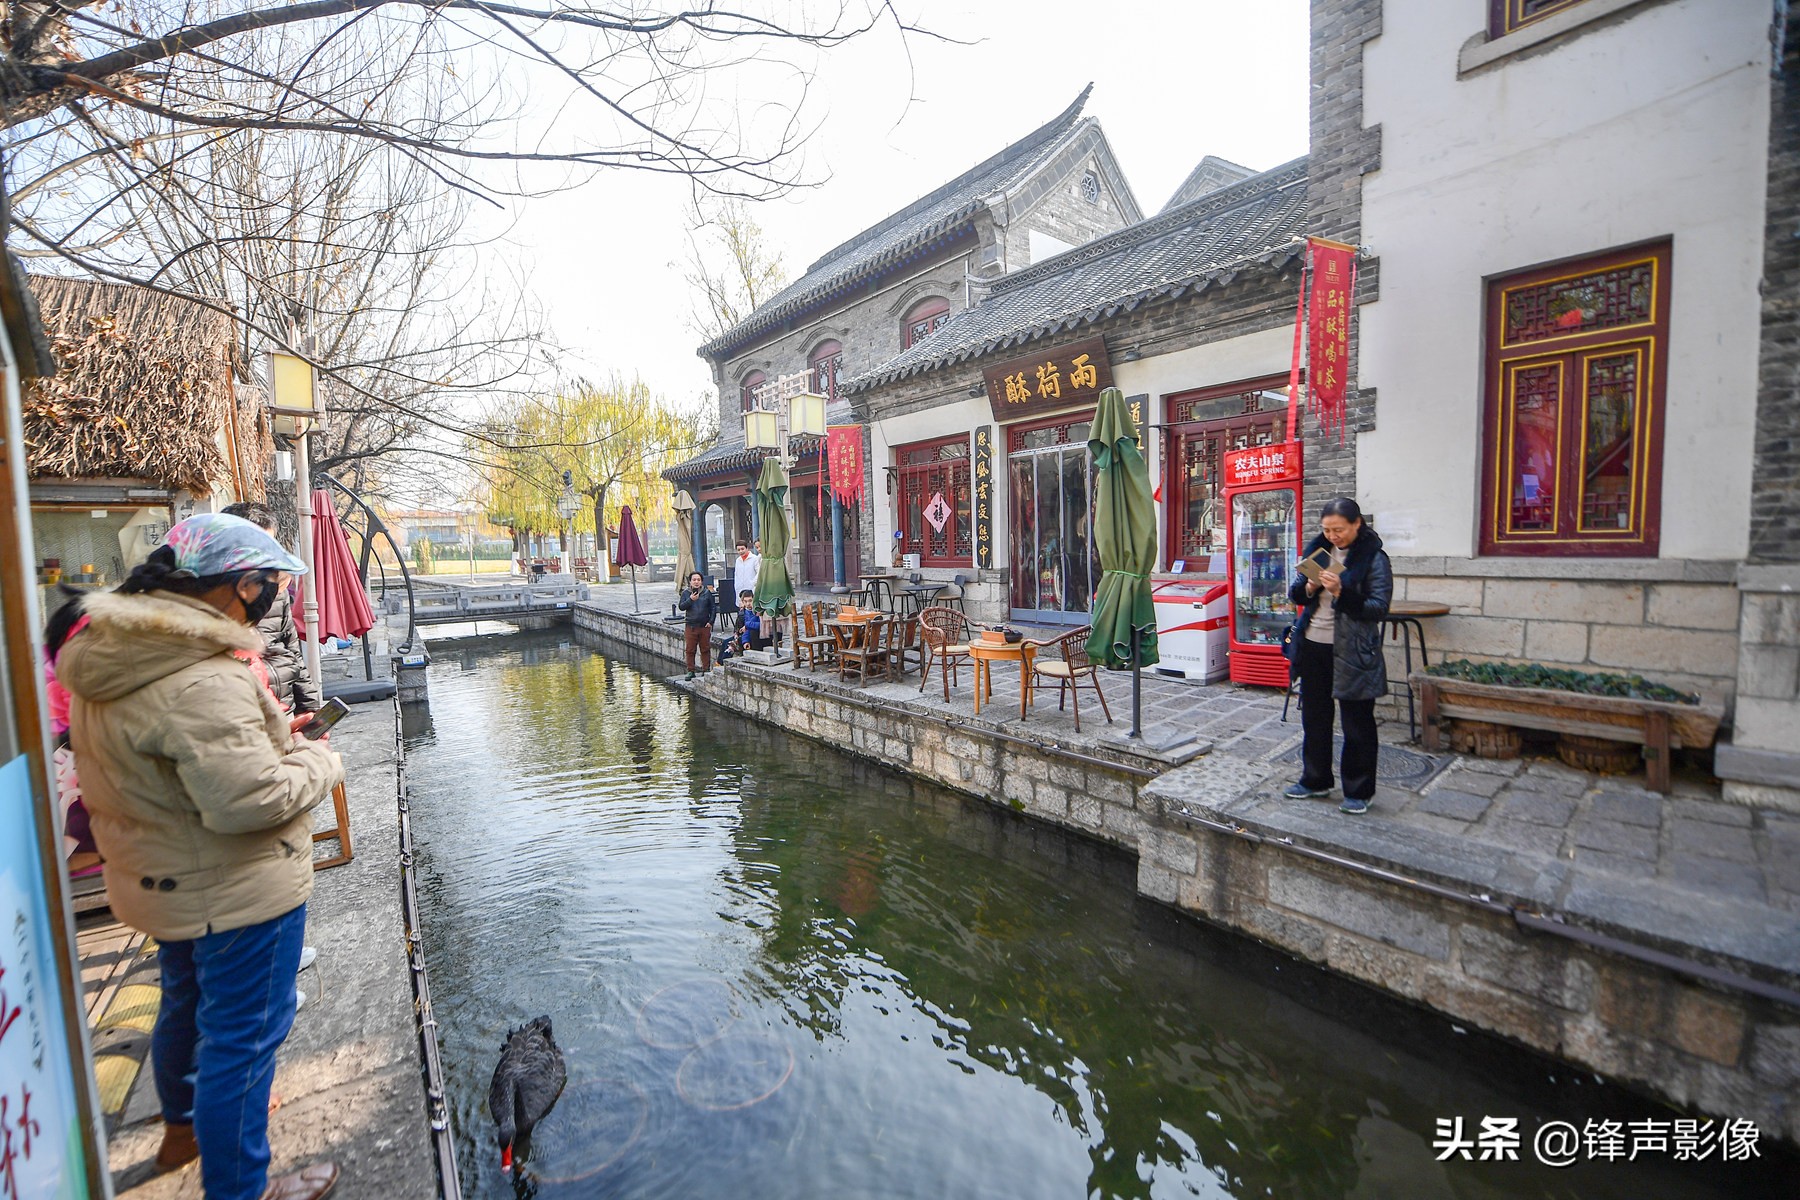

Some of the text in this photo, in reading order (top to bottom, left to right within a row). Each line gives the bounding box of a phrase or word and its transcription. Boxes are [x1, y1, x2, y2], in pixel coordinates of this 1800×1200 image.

[1325, 289, 1338, 390] 品酥喝茶
[1004, 353, 1097, 403] 雨荷酥
[1234, 453, 1285, 471] 农夫山泉
[1235, 467, 1285, 479] NONGFU SPRING
